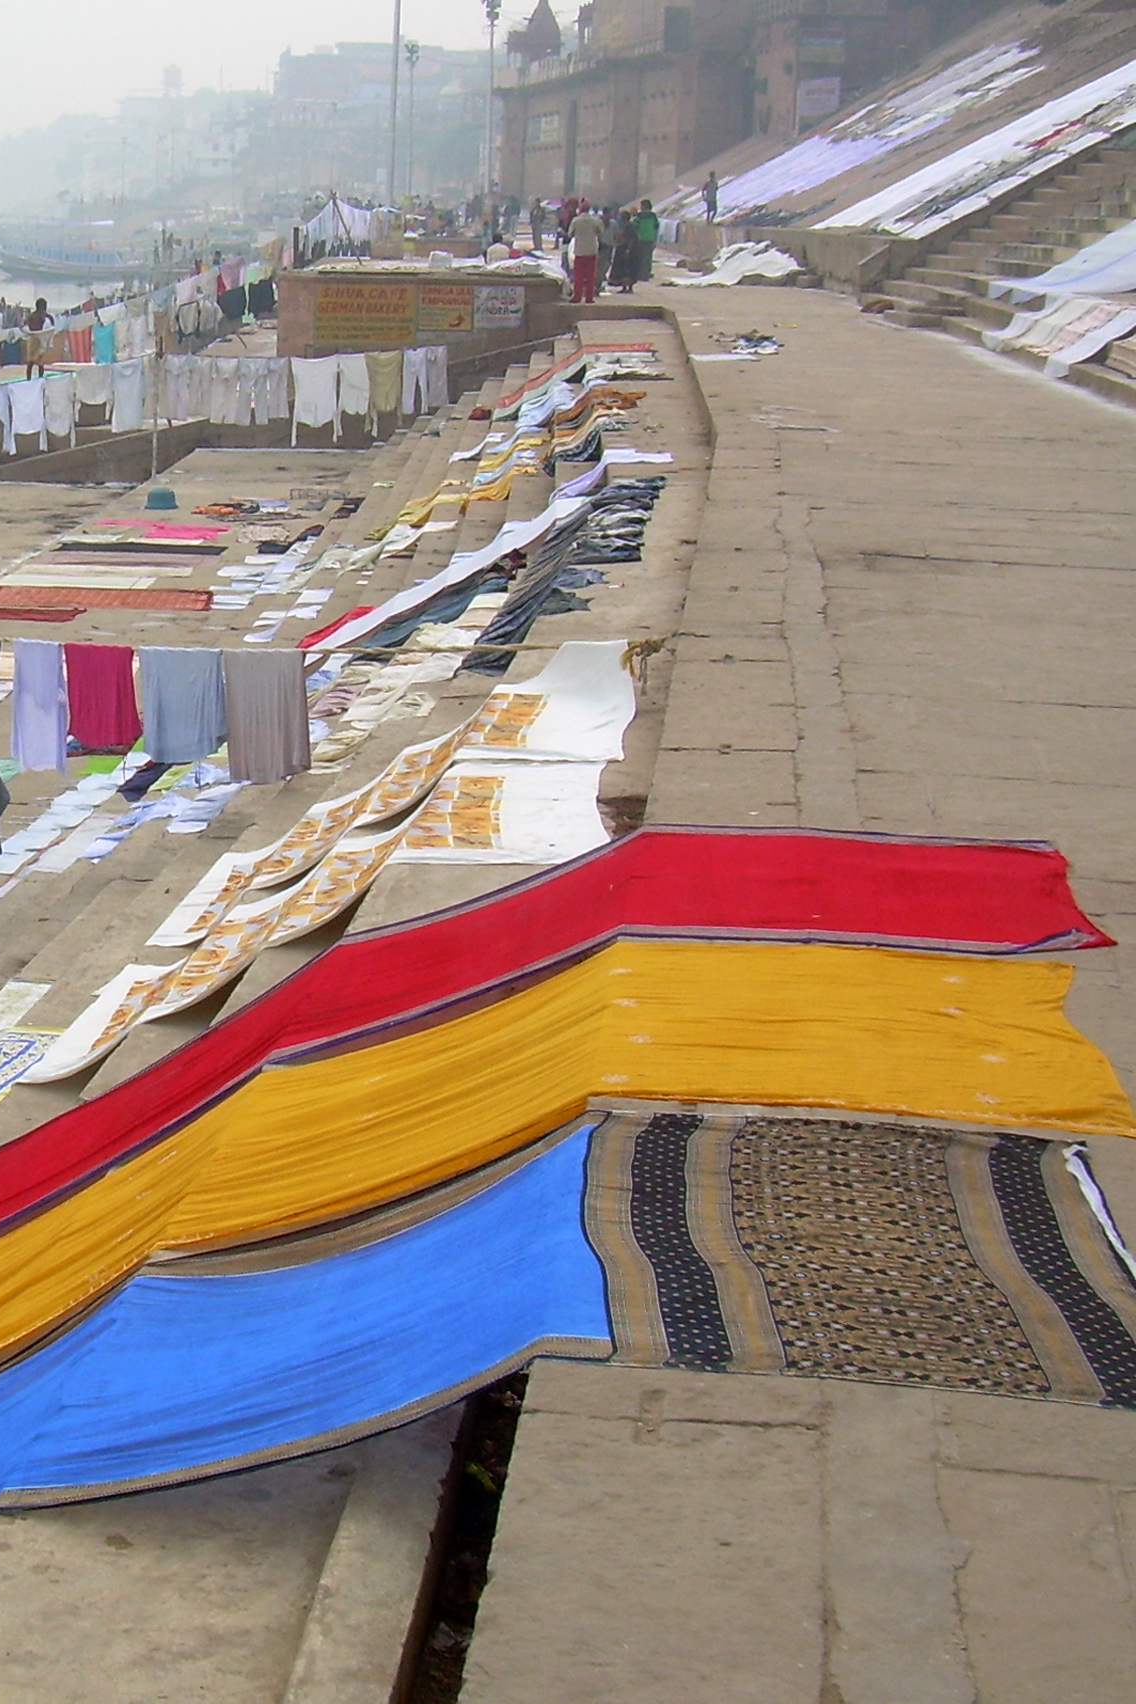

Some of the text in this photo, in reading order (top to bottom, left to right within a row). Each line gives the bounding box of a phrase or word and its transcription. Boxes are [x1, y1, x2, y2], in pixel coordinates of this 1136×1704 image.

[323, 287, 408, 300] SHIVA CAFE
[317, 301, 410, 314] GERMAN BAKERY
